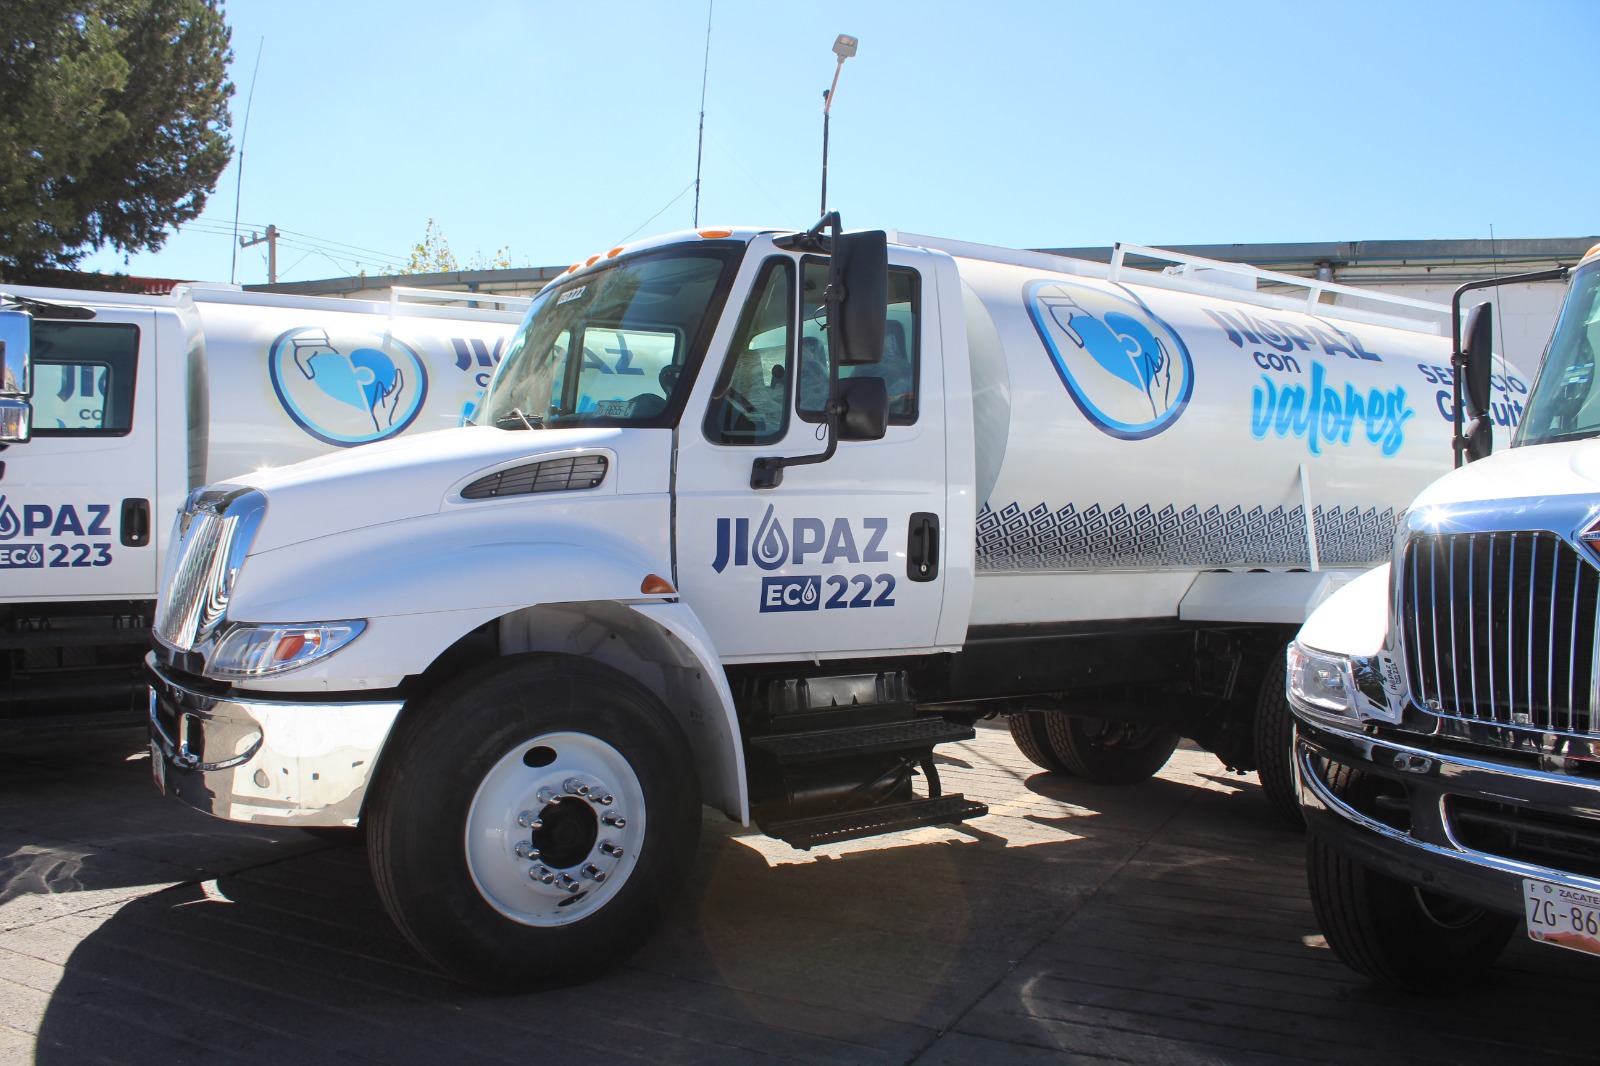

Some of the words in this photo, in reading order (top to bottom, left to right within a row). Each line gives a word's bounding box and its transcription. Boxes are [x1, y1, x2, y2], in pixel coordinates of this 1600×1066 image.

[1253, 351, 1301, 373] con
[1251, 359, 1415, 458] valores
[48, 543, 113, 567] 223
[824, 573, 896, 609] 222
[1559, 889, 1600, 905] ZACATE
[1529, 897, 1600, 935] ZG-86
